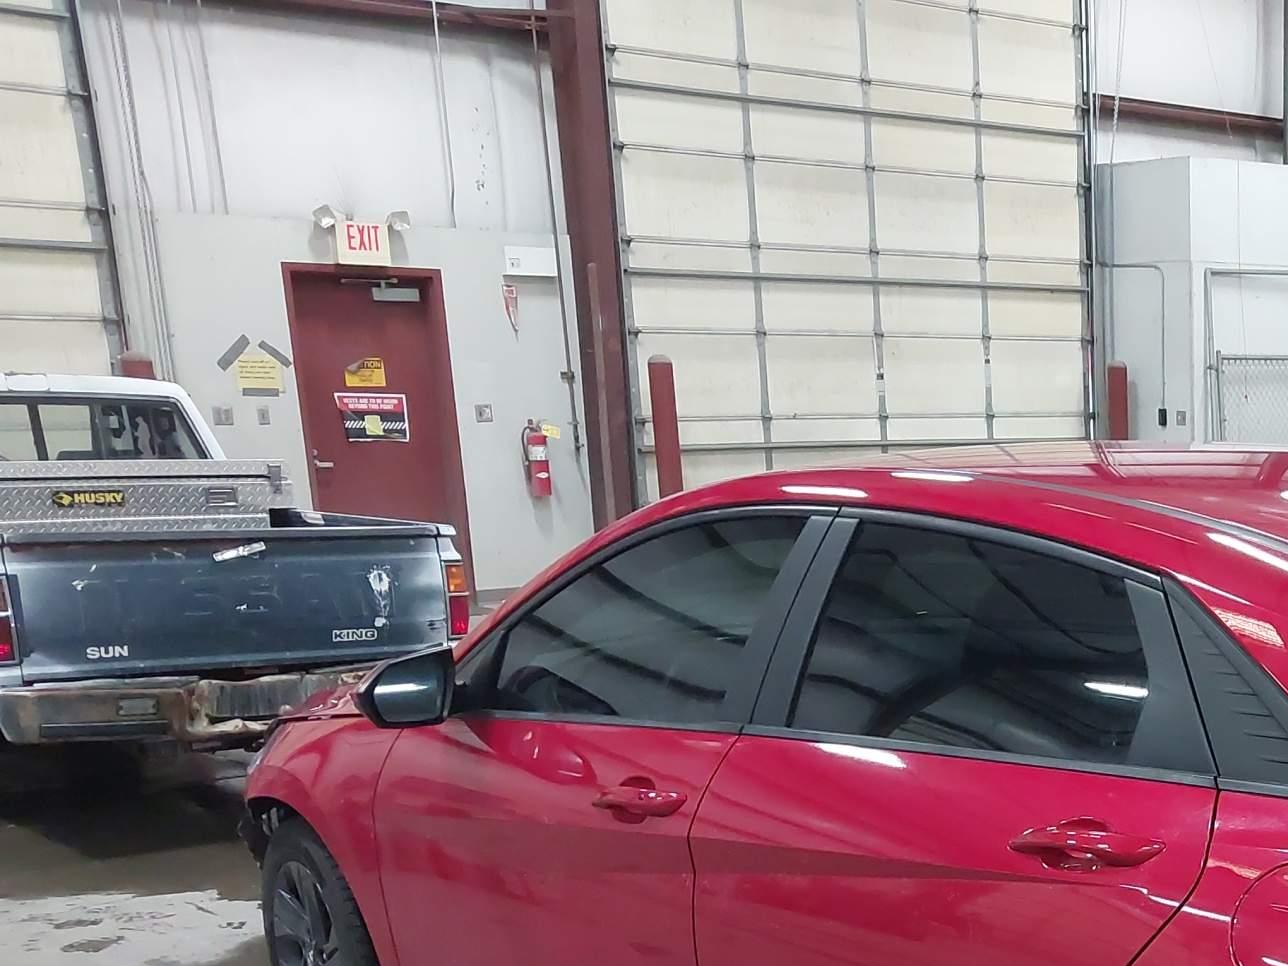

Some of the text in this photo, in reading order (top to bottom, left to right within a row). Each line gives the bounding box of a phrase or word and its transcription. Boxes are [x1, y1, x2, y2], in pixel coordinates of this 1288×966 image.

[346, 224, 380, 252] EXIT
[73, 492, 124, 503] HUSKY
[332, 628, 378, 642] KING
[86, 645, 129, 659] SUN
